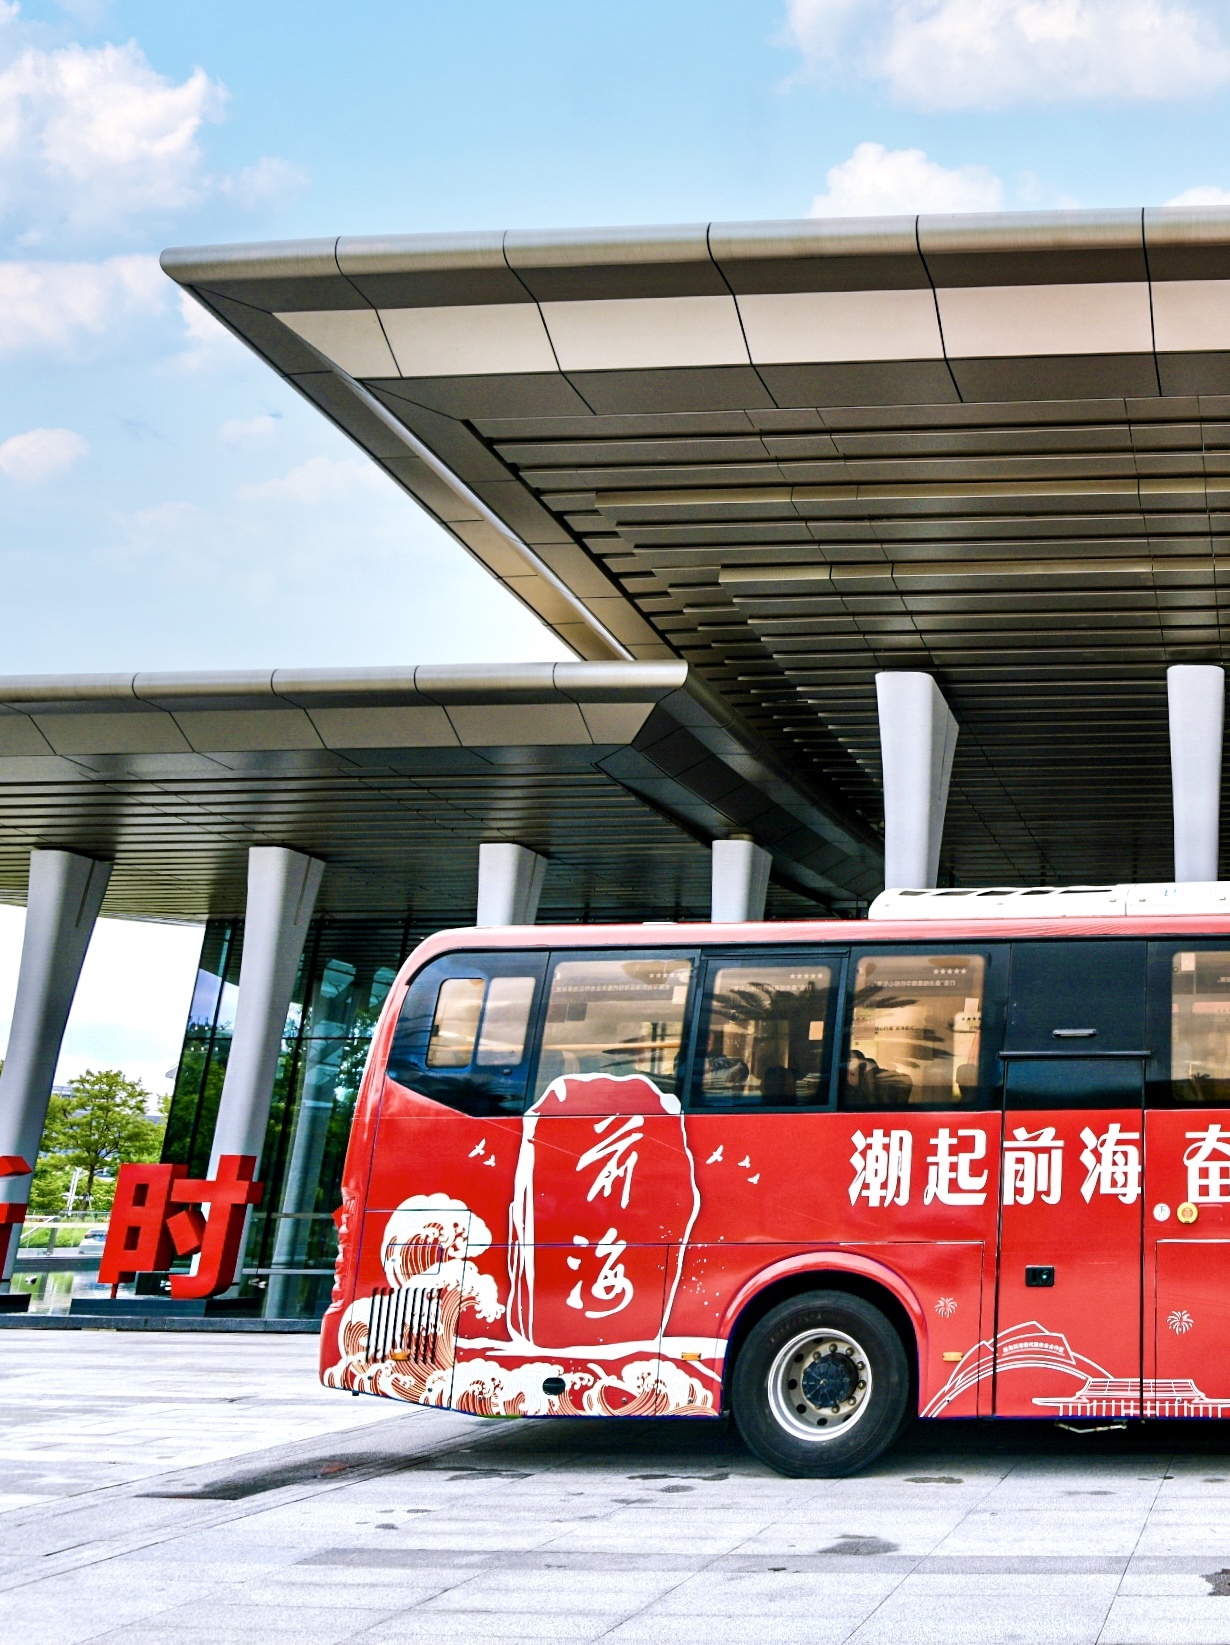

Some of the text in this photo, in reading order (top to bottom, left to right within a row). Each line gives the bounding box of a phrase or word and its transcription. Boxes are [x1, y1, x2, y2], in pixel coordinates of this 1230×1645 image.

[0, 1155, 264, 1300] 时
[566, 1114, 645, 1319] 前海
[848, 1123, 1143, 1208] 潮起前海
